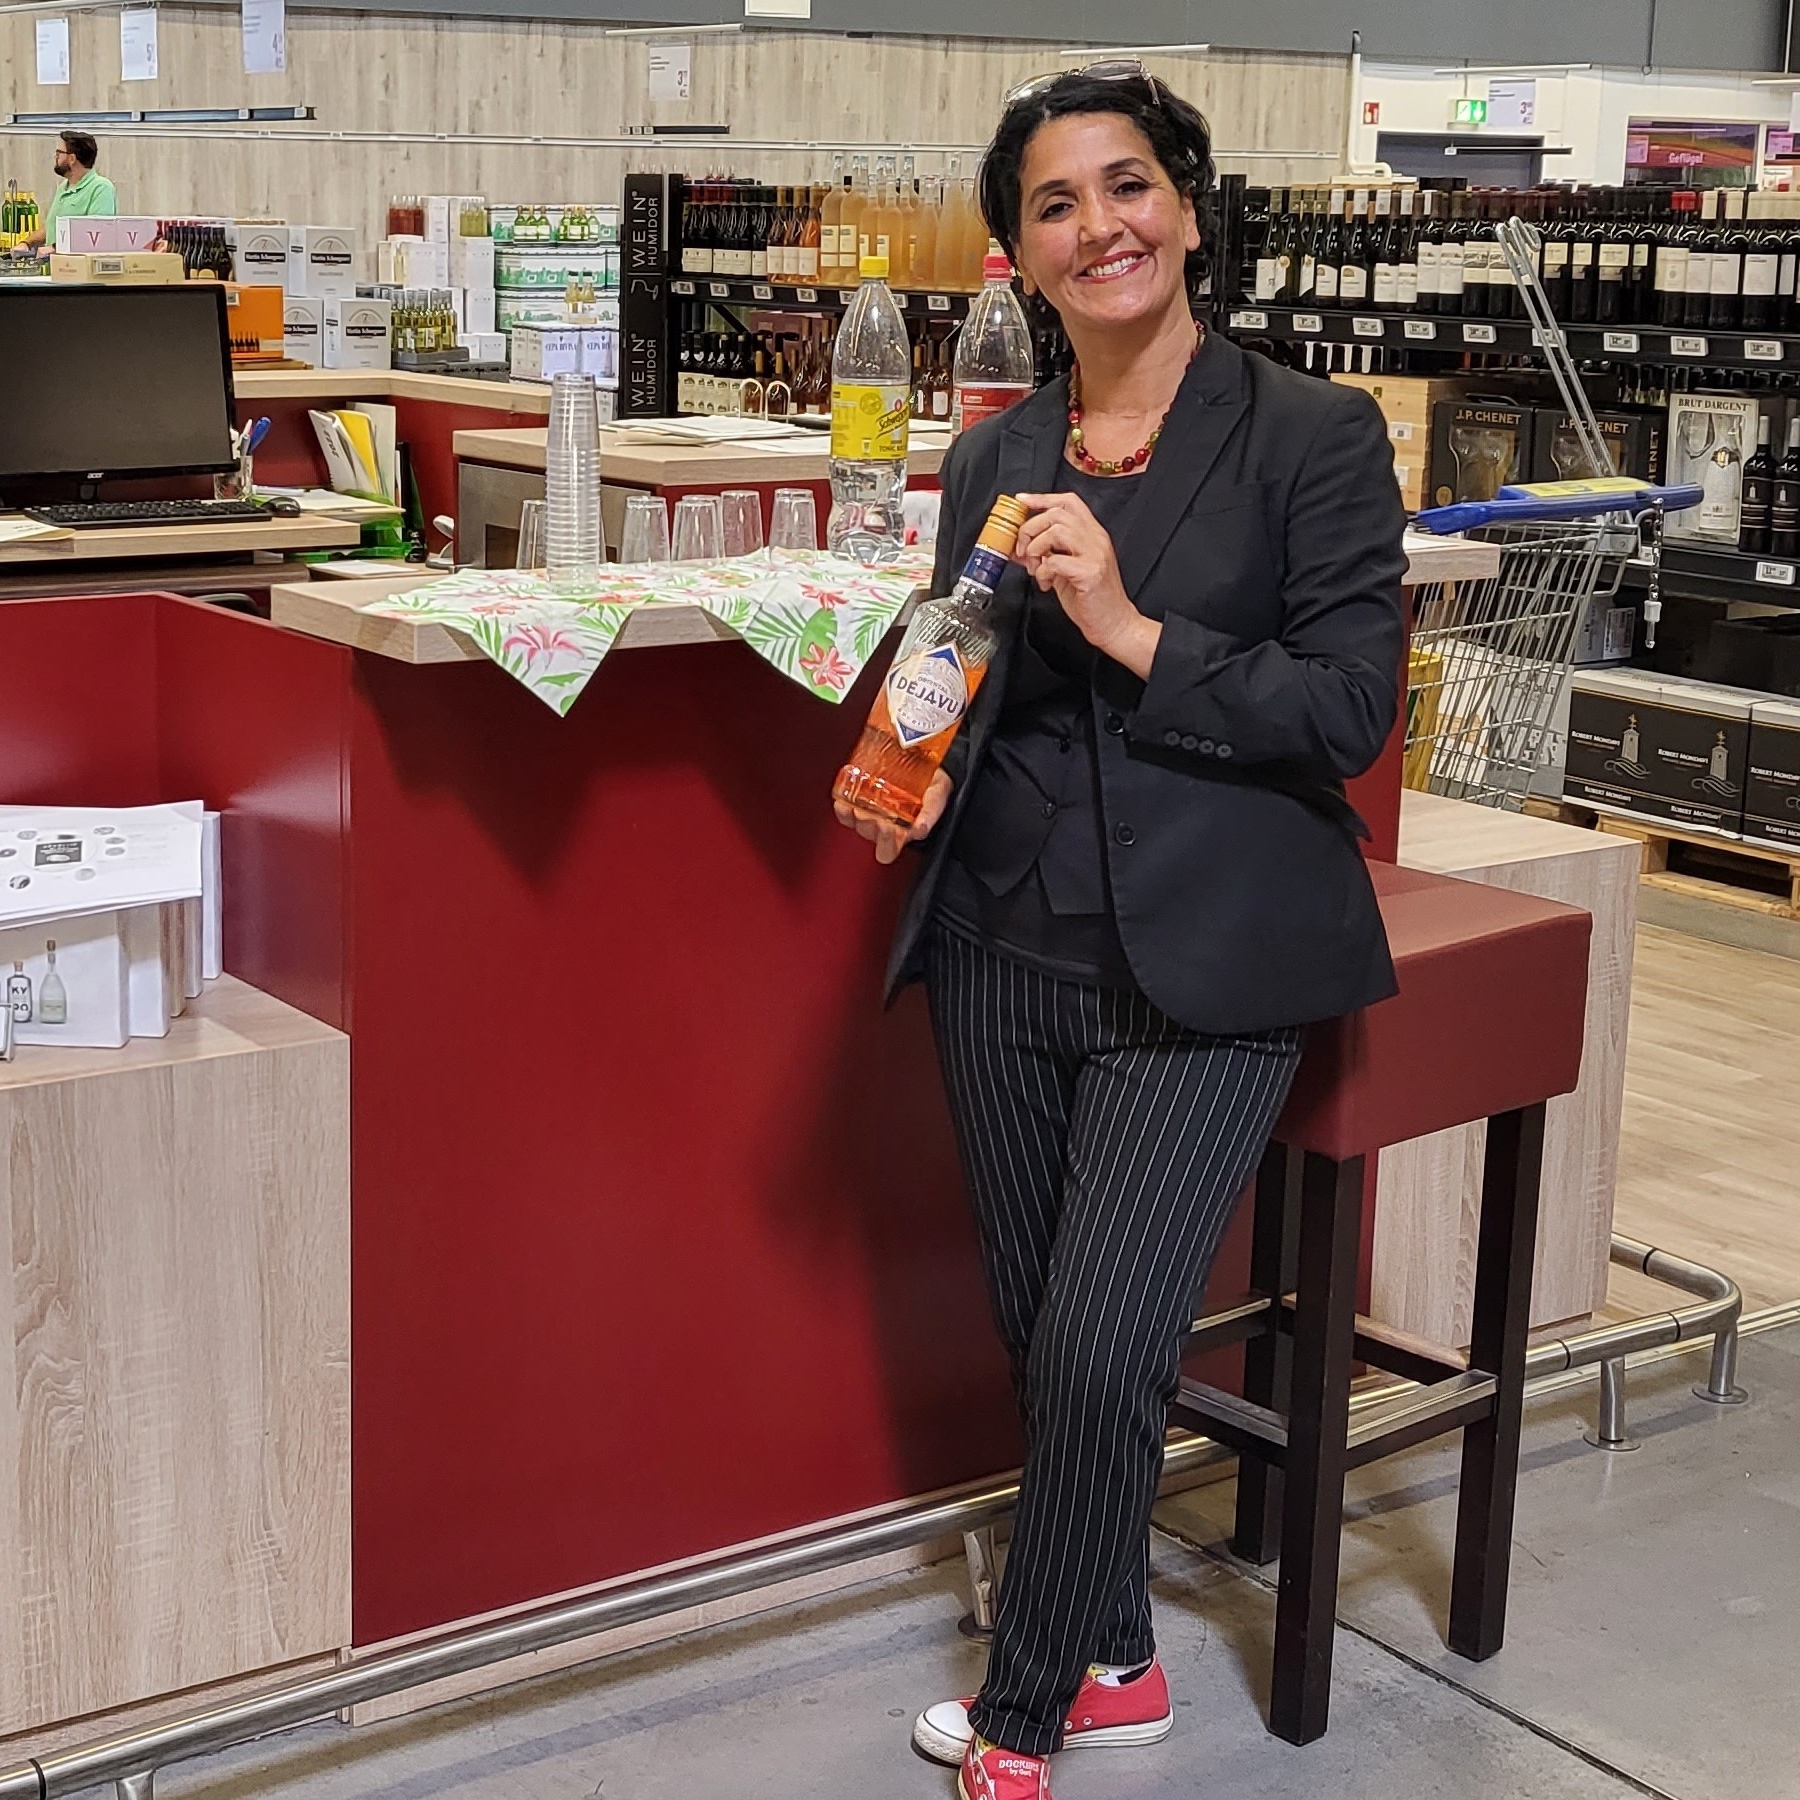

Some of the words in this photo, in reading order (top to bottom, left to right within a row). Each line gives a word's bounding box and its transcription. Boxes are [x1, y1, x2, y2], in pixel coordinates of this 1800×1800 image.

[1668, 152, 1704, 166] Geflügel
[647, 197, 658, 266] HUMIDOR
[646, 339, 657, 405] HUMIDOR
[1678, 397, 1703, 409] BRUT
[1474, 410, 1522, 425] CHENET
[12, 986, 27, 995] KY
[998, 1759, 1040, 1773] DOCKERS
